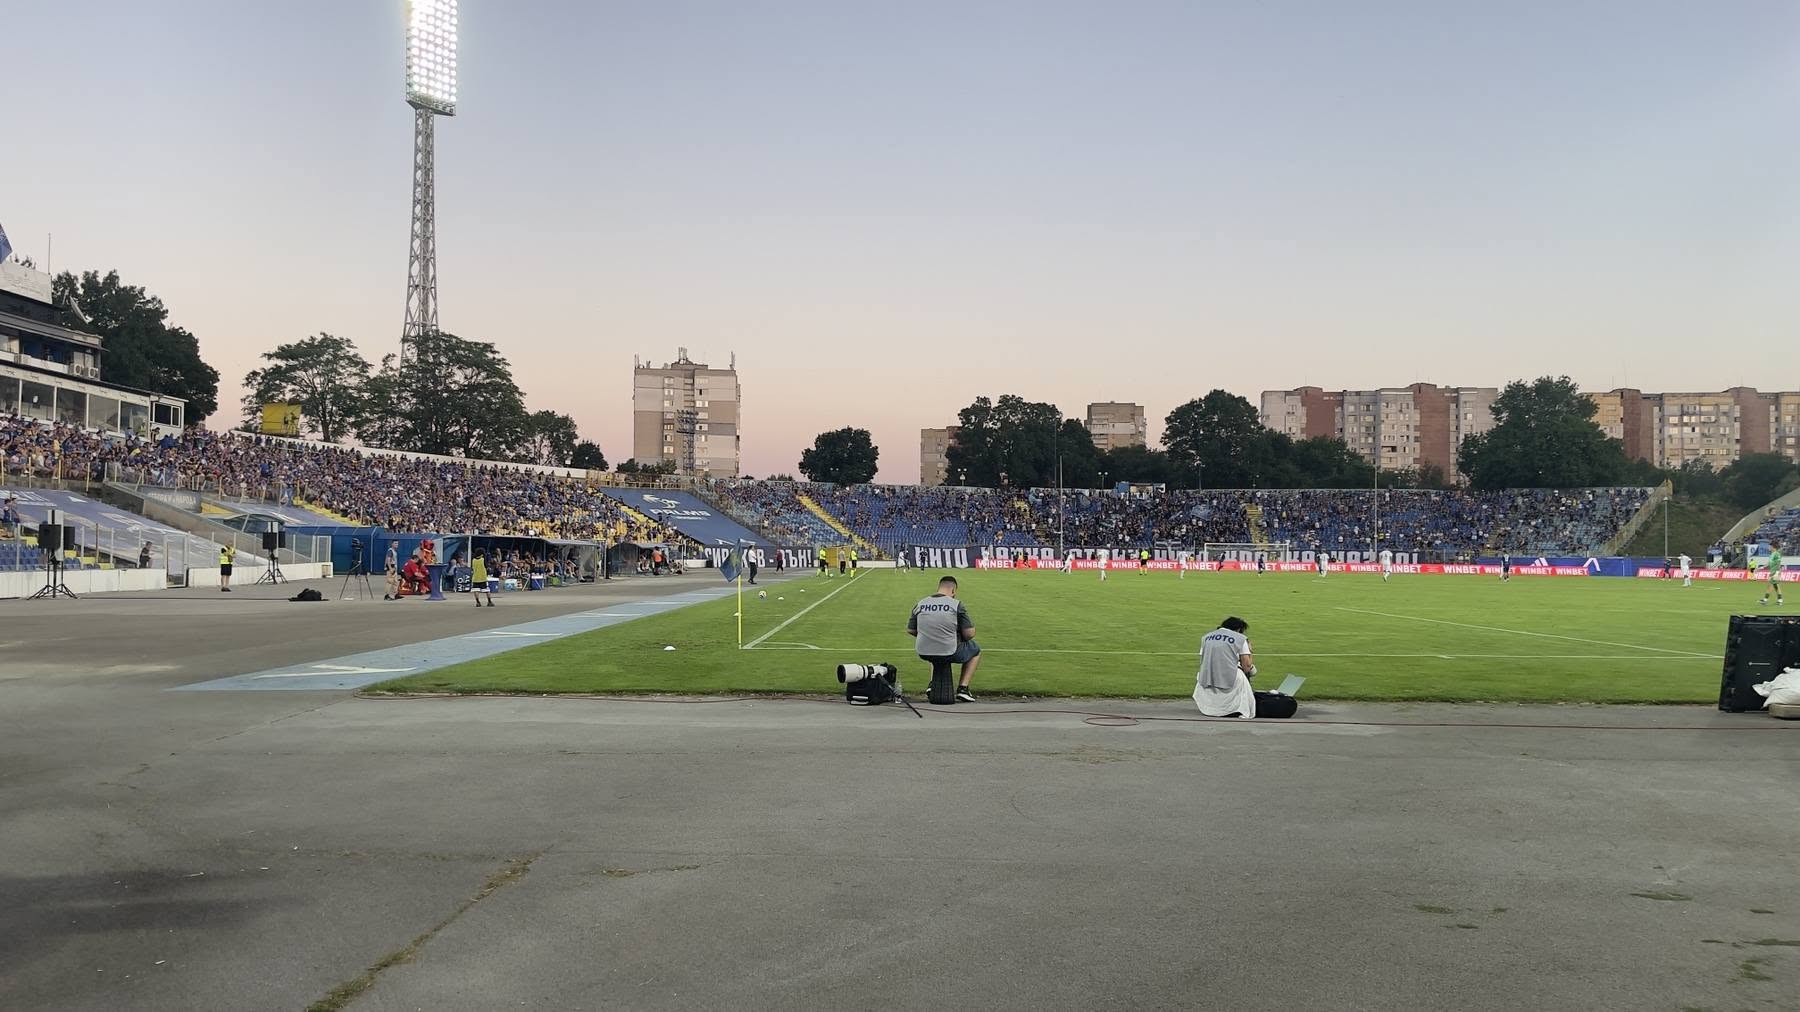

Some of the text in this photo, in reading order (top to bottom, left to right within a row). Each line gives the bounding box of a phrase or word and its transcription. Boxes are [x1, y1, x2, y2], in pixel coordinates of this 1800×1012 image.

[704, 547, 766, 568] СИРКВ
[1077, 561, 1107, 569] WINB
[1111, 561, 1141, 569] WINBET
[1147, 561, 1178, 569] WINBET
[1240, 562, 1277, 571] WINET
[1280, 563, 1313, 571] WINBET
[1350, 564, 1382, 572] WINBET
[1443, 565, 1480, 574] WINBET
[1485, 566, 1516, 574] WINET
[1520, 567, 1552, 575] WINBET
[1555, 567, 1588, 576] WINBET
[1638, 568, 1662, 577] WINBET
[1673, 569, 1697, 578] WET
[1205, 634, 1235, 644] PHOTO
